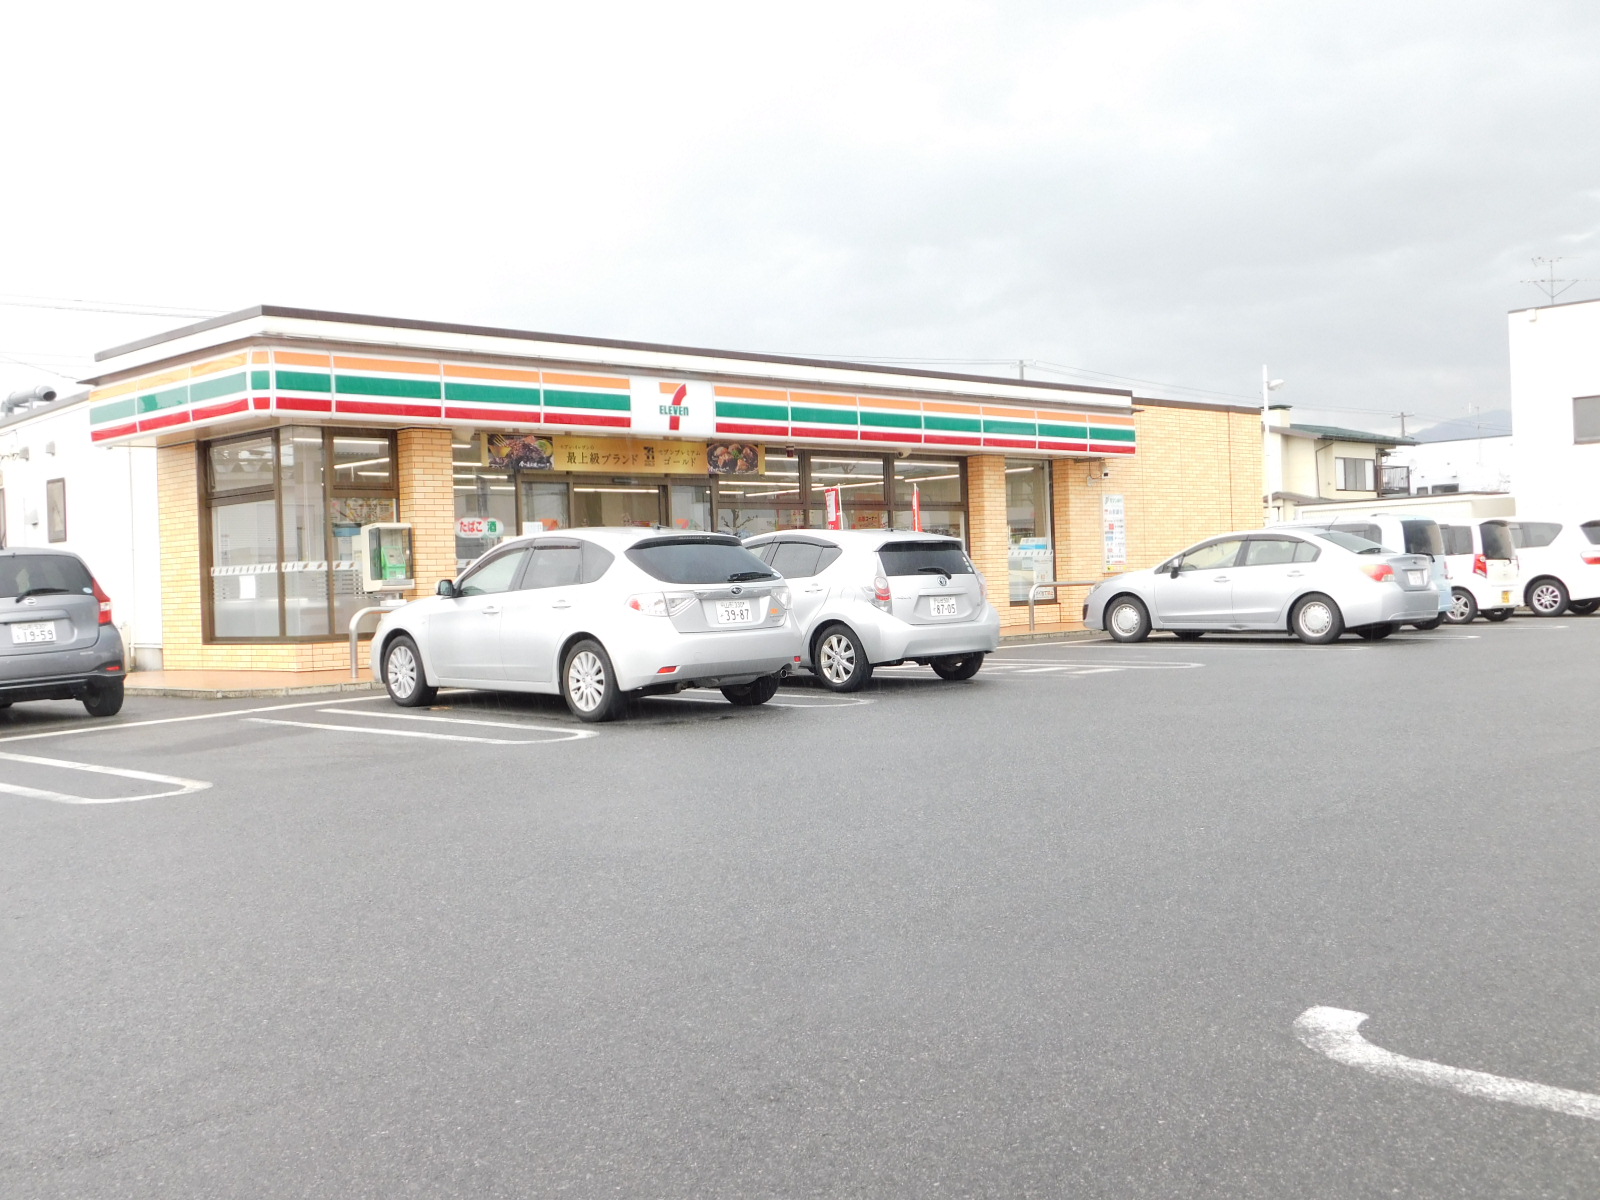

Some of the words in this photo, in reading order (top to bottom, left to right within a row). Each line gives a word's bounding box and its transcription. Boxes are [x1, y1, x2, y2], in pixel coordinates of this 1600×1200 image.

[567, 451, 639, 466] 最上級ブランド
[663, 457, 697, 468] ゴールド
[460, 521, 483, 533] たばこ
[487, 520, 497, 533] 酒
[724, 608, 749, 621] 39-87
[936, 603, 956, 614] 87-05
[24, 629, 54, 642] 19-59
